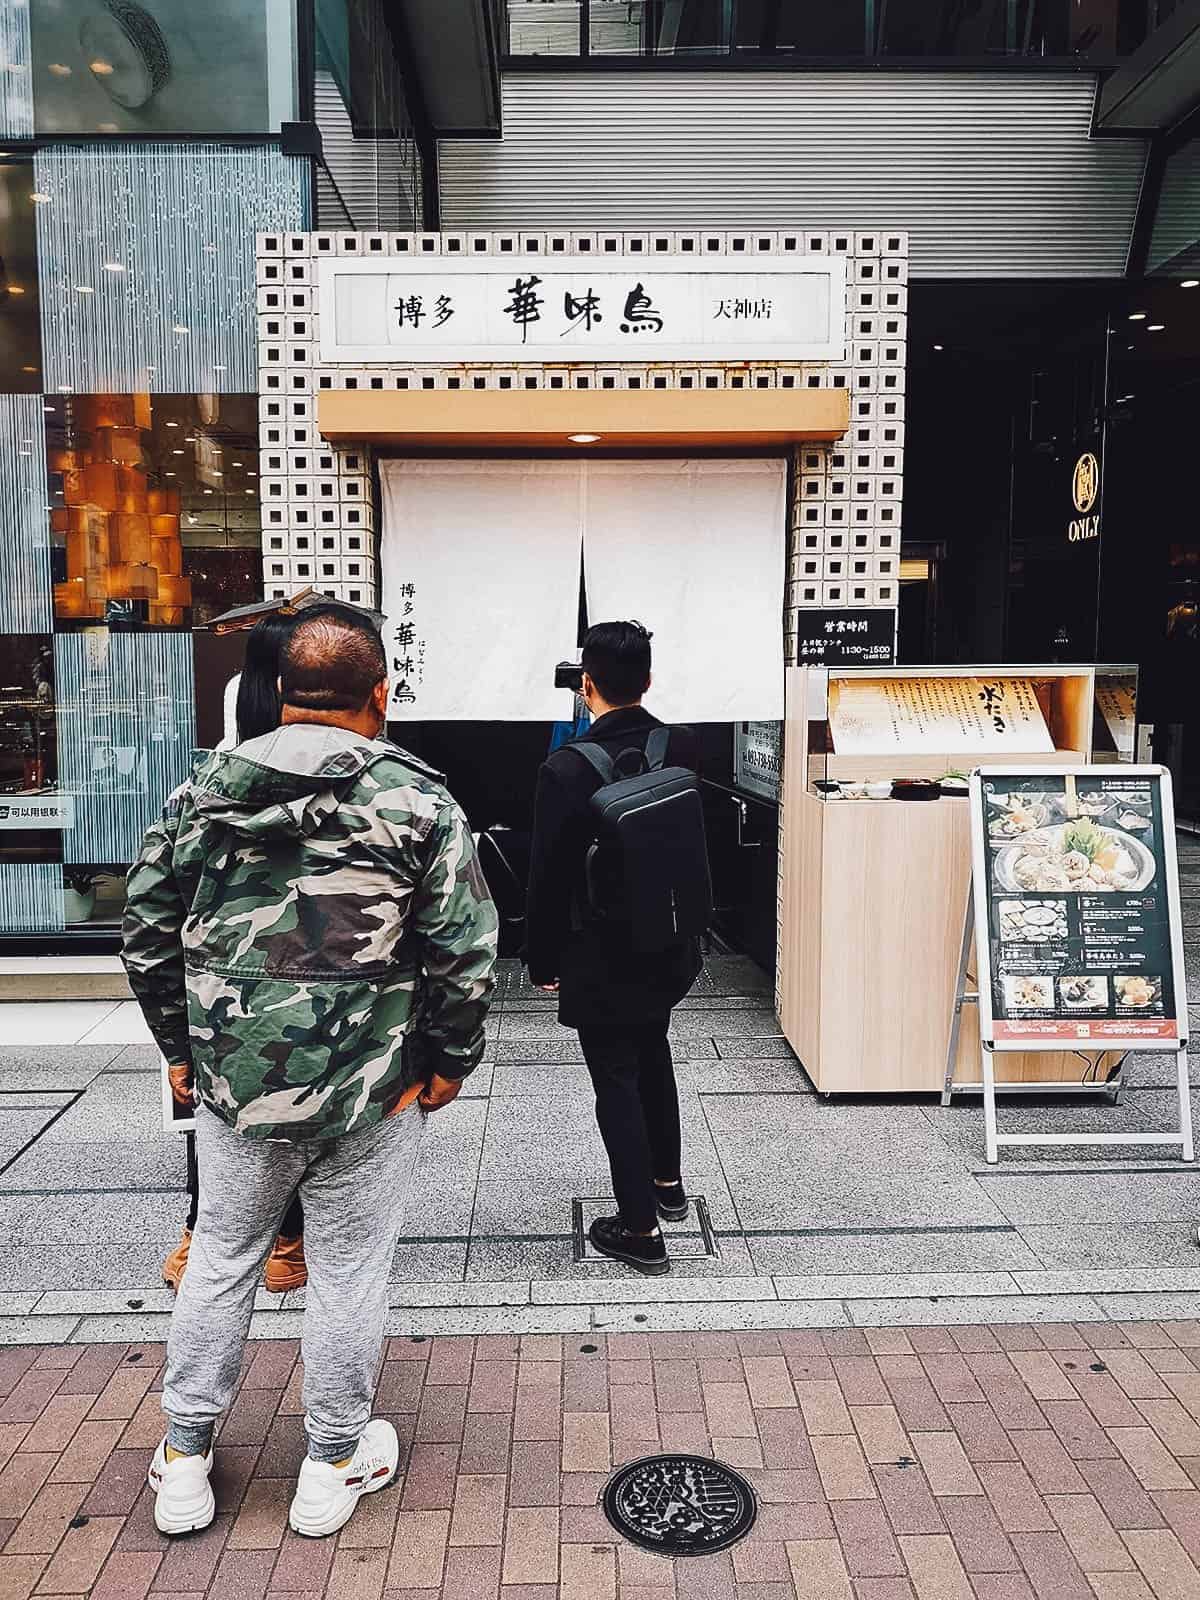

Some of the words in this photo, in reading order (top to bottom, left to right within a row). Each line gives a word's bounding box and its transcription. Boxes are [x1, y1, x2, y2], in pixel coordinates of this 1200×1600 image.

[394, 294, 455, 328] 博多
[503, 275, 663, 343] 華味鳥
[713, 297, 773, 320] 天神店
[1068, 514, 1100, 542] ONLY
[399, 583, 417, 617] 博多
[824, 620, 868, 633] 営業時間
[392, 621, 417, 704] 華味鳥
